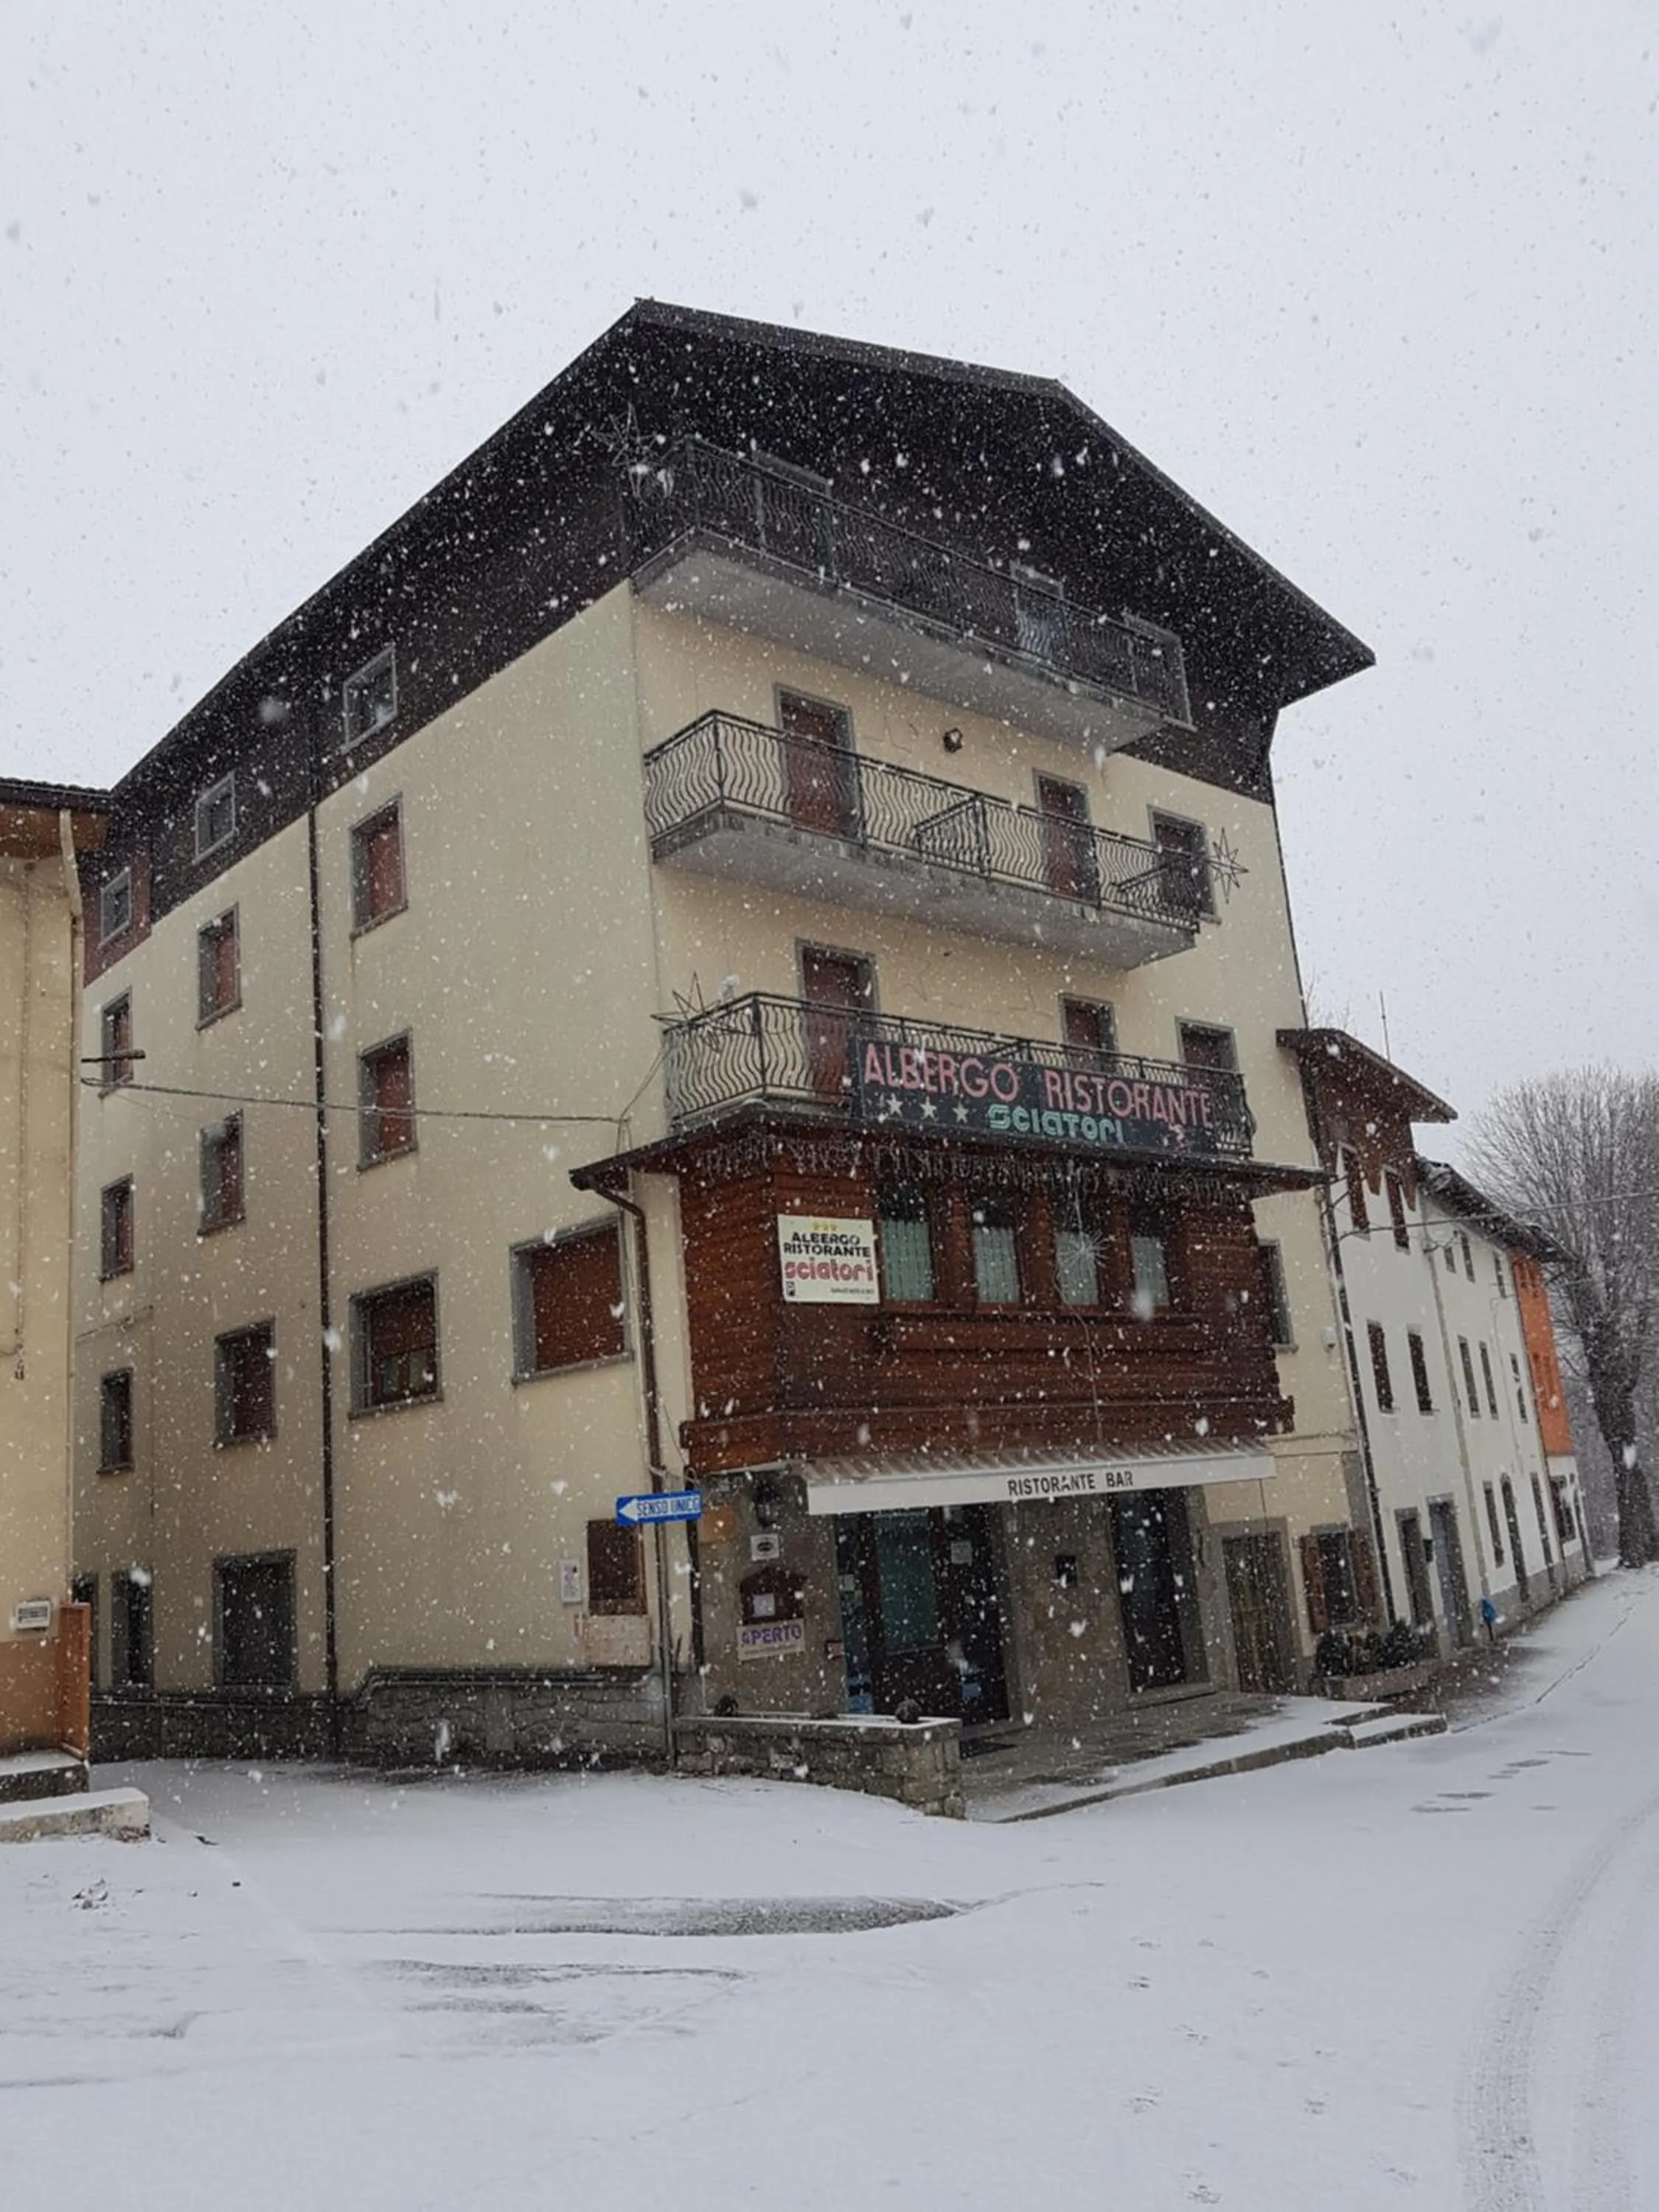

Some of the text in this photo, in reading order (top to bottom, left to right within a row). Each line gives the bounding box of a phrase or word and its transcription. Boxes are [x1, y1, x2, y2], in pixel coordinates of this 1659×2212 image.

[863, 1043, 1214, 1130] ALBERGO RISTORANTE
[783, 1242, 872, 1258] RISTORANTE
[791, 1231, 860, 1245] ALBERGO
[785, 1256, 874, 1282] sciatori
[1007, 1470, 1134, 1497] RISTORANTE BAR
[636, 1496, 700, 1517] SENSO UNICO
[740, 1624, 802, 1648] APERTO
